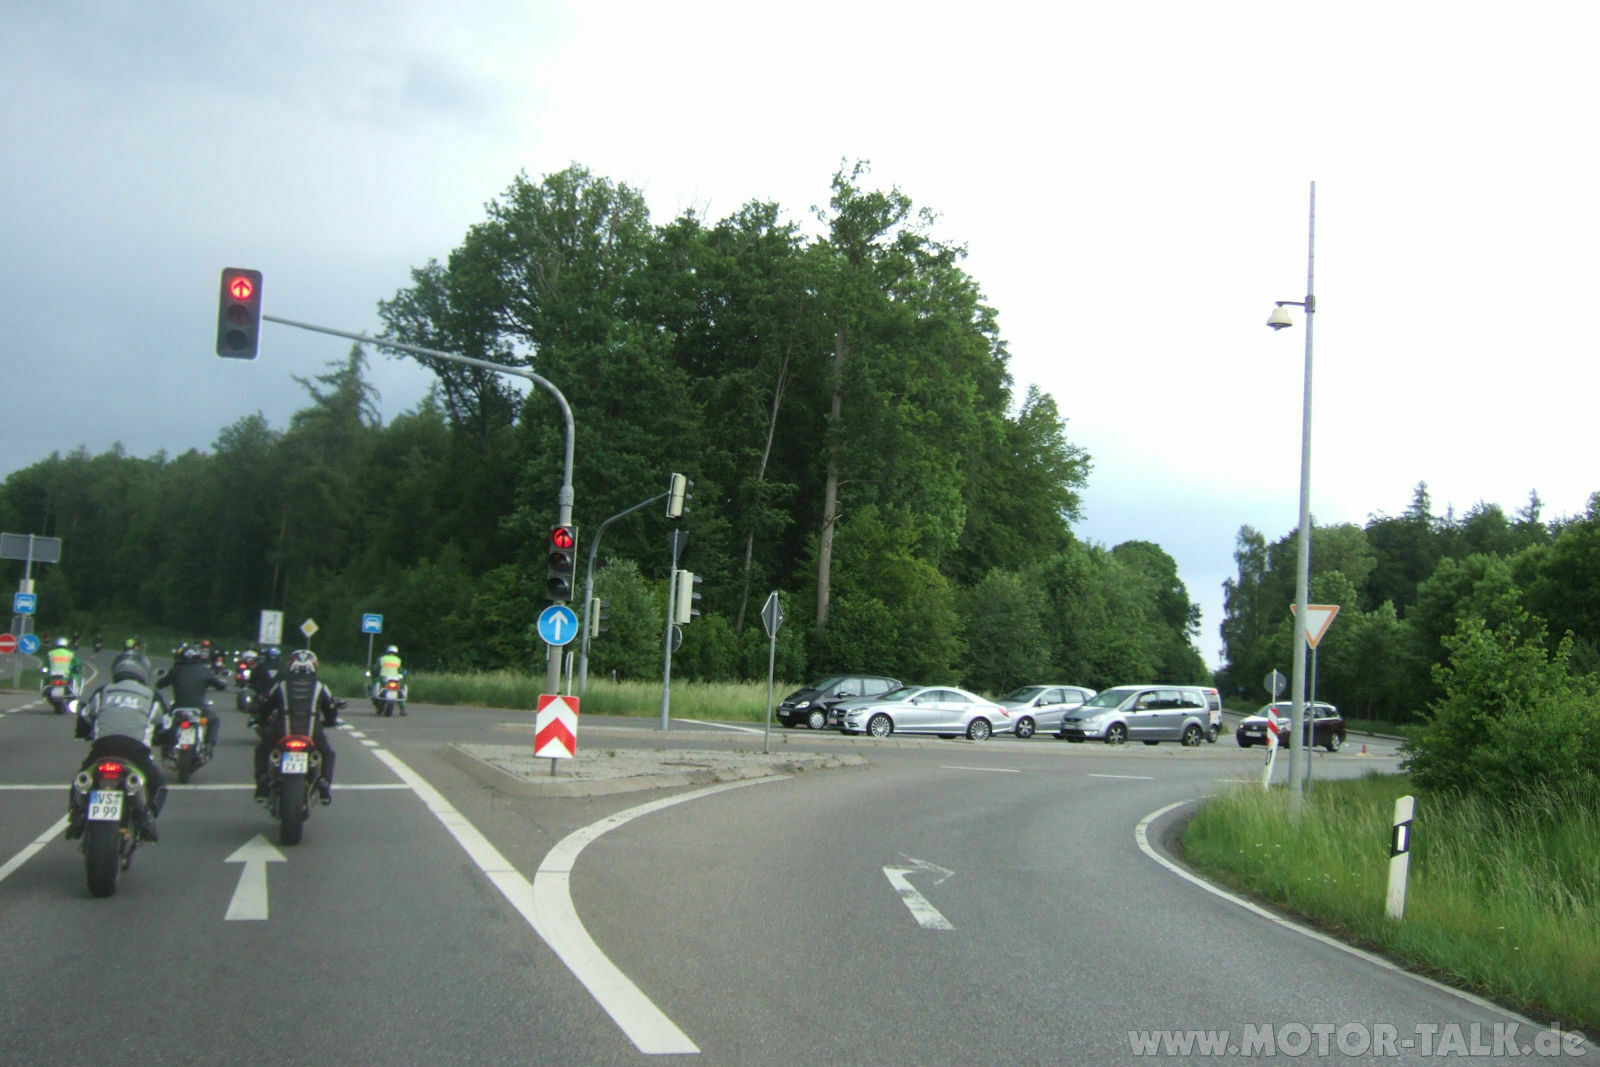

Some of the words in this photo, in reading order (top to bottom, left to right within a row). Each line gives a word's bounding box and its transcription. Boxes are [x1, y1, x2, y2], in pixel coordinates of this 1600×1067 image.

[98, 792, 113, 805] VS
[92, 805, 100, 817] P
[103, 805, 118, 817] 99
